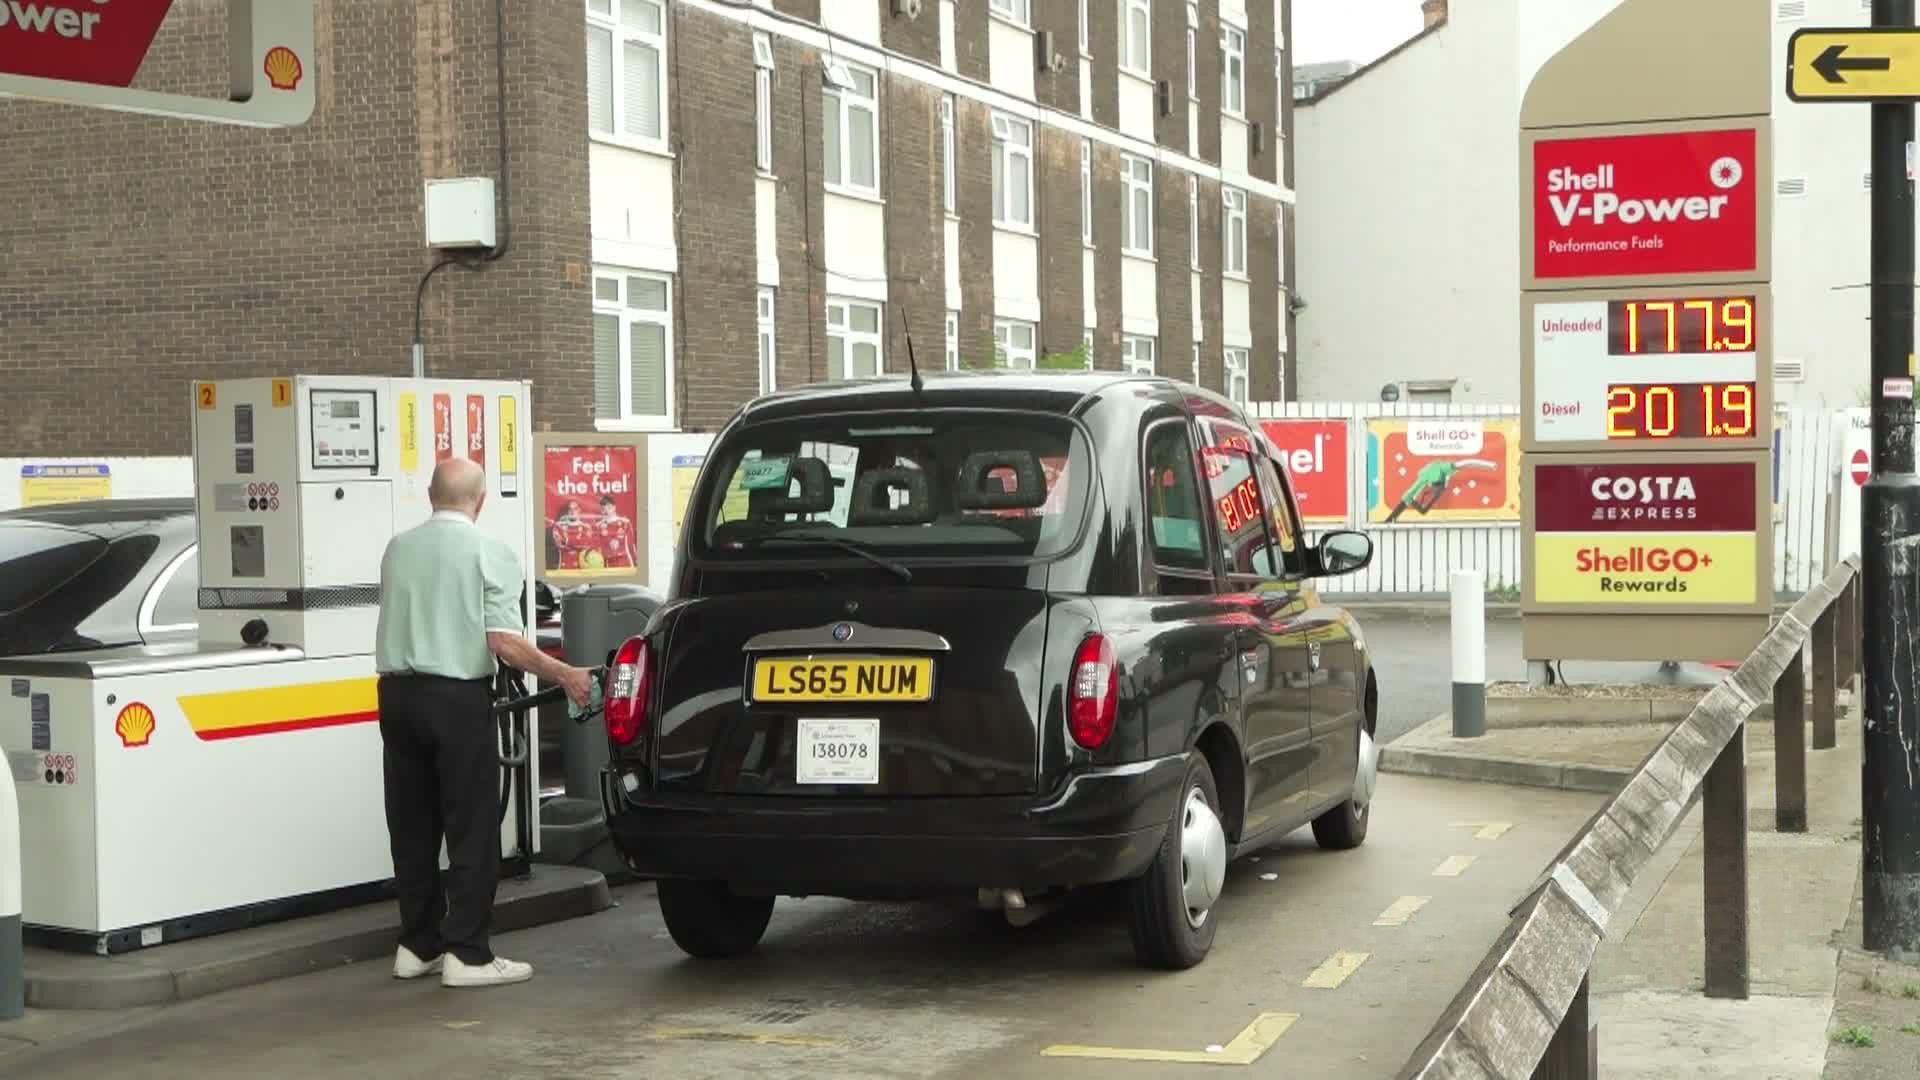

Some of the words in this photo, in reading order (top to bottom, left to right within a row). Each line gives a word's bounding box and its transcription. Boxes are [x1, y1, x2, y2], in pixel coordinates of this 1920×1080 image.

[1548, 163, 1614, 192] Shell
[1548, 193, 1729, 227] V-Power
[1549, 237, 1629, 253] Performance
[1631, 234, 1664, 249] Fuels
[1541, 318, 1603, 333] Unleaded
[1626, 299, 1752, 352] 177.9
[202, 387, 213, 405] 2
[278, 384, 286, 401] 1
[1541, 401, 1581, 416] Diesel
[1416, 429, 1445, 441] Shell
[572, 454, 610, 475] Feel
[557, 475, 588, 495] the
[592, 474, 628, 494] fuel
[1591, 476, 1697, 504] COSTA
[1607, 507, 1697, 519] EXPRESS
[1600, 577, 1687, 592] Rewards
[767, 665, 848, 694] LS65
[856, 665, 917, 694] NUM
[812, 743, 868, 759] 138078
